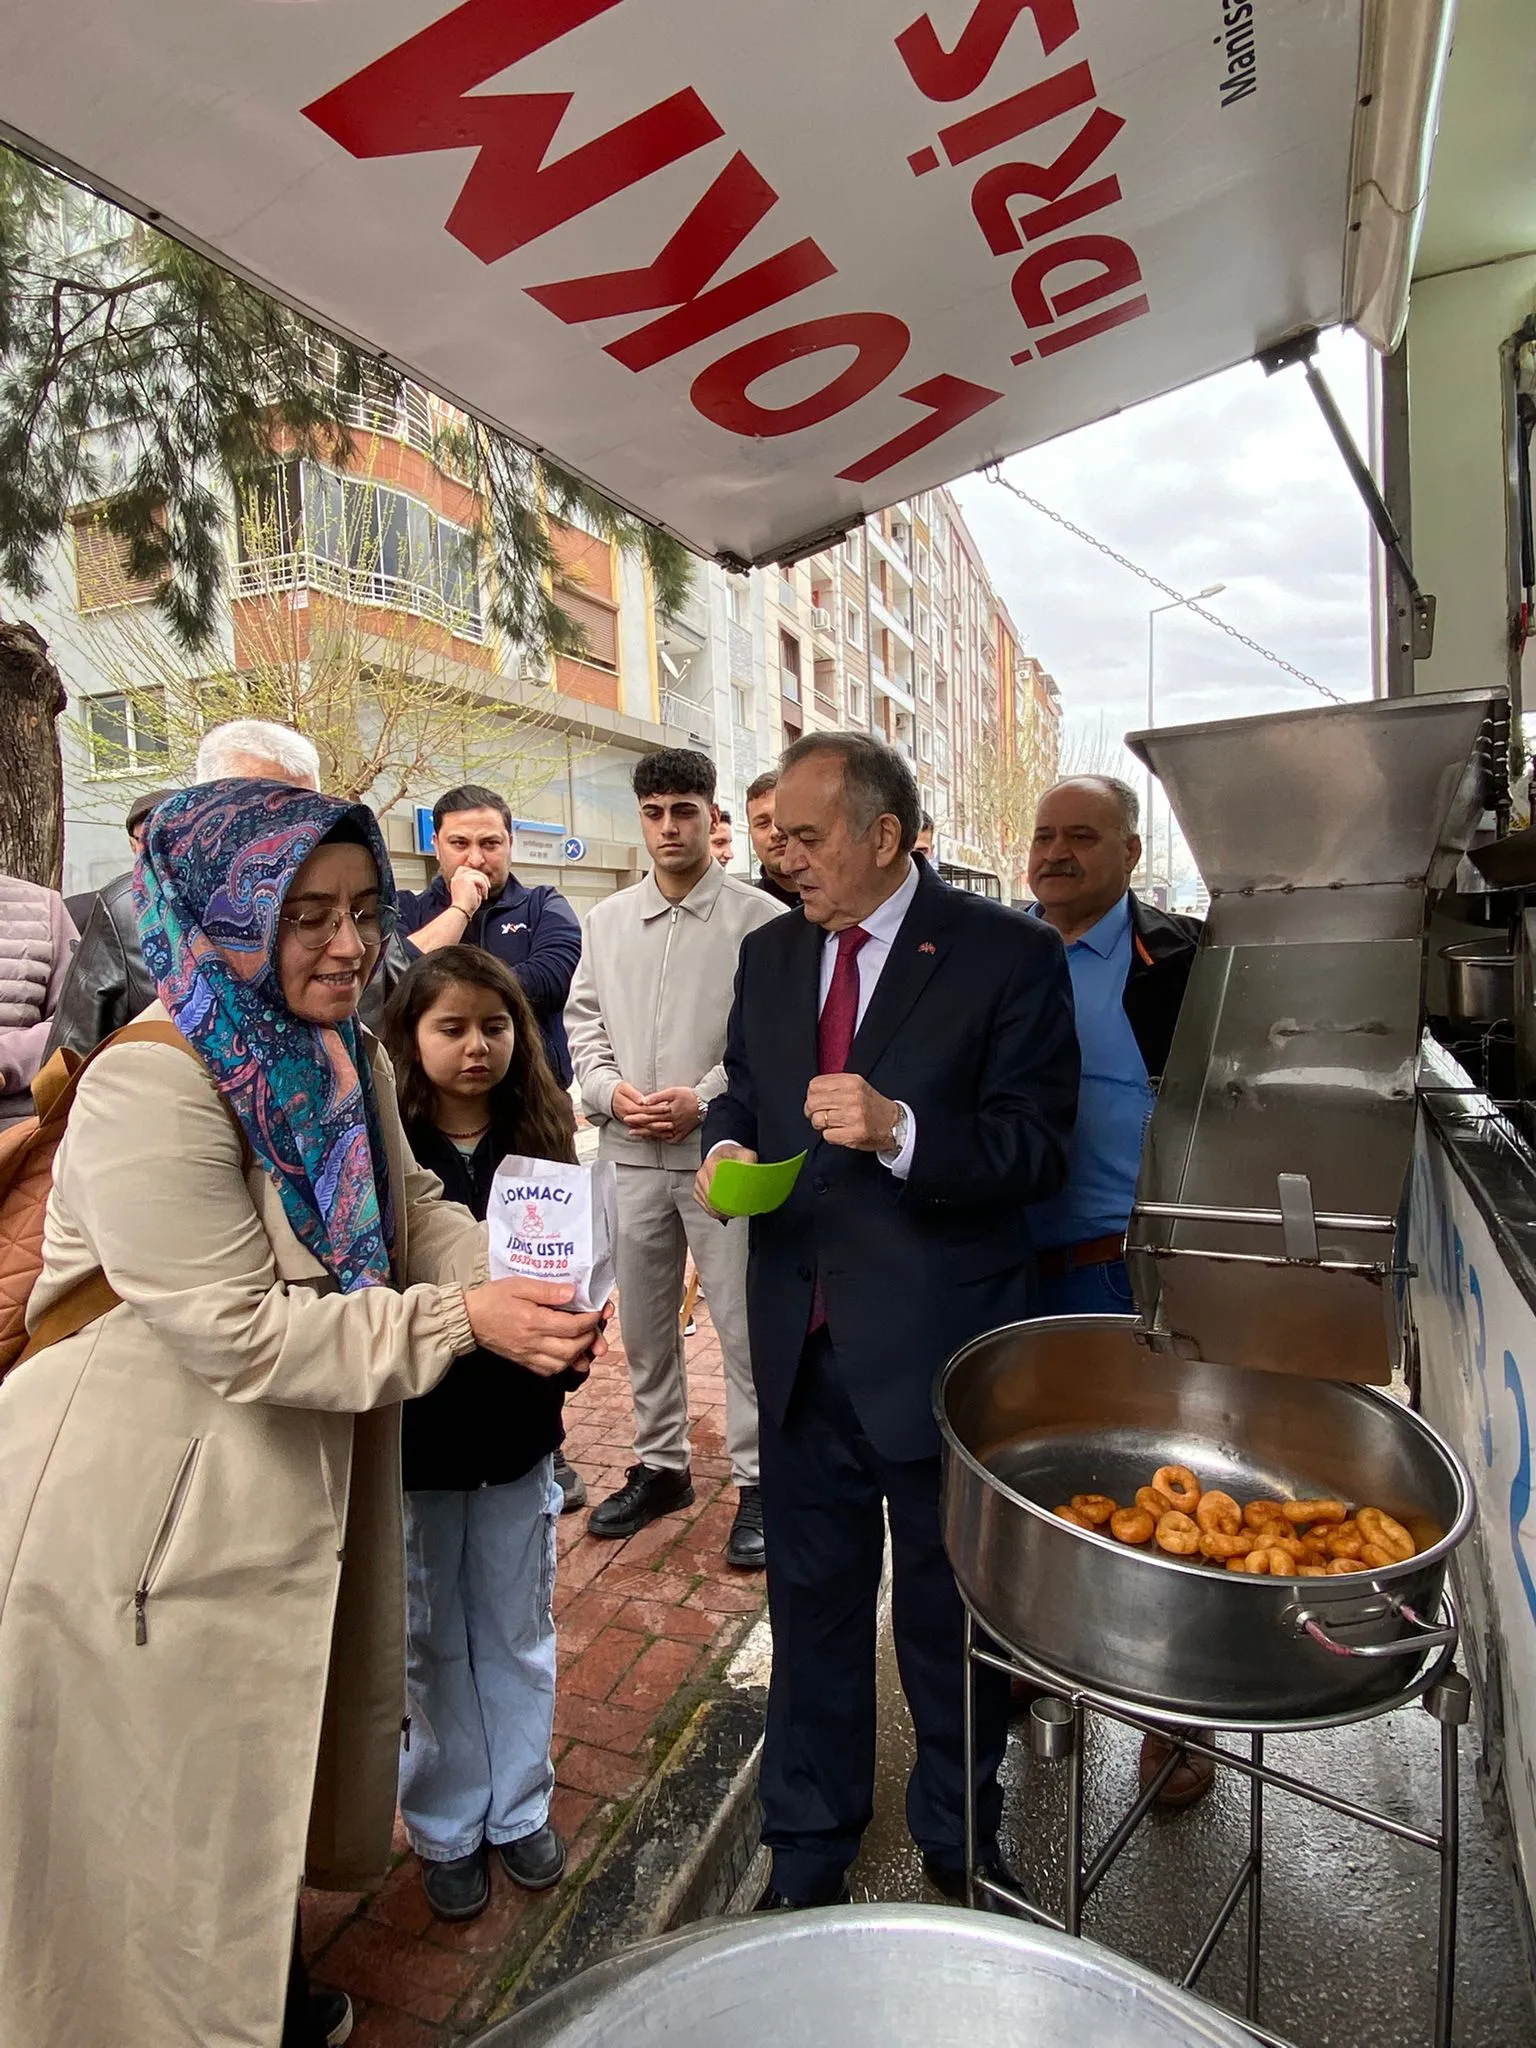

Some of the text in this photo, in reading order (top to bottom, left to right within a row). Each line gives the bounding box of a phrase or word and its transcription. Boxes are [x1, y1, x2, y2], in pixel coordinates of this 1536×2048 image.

[501, 1186, 573, 1205] LOKMACI
[537, 1241, 574, 1256] USTA
[556, 1259, 568, 1269] 20
